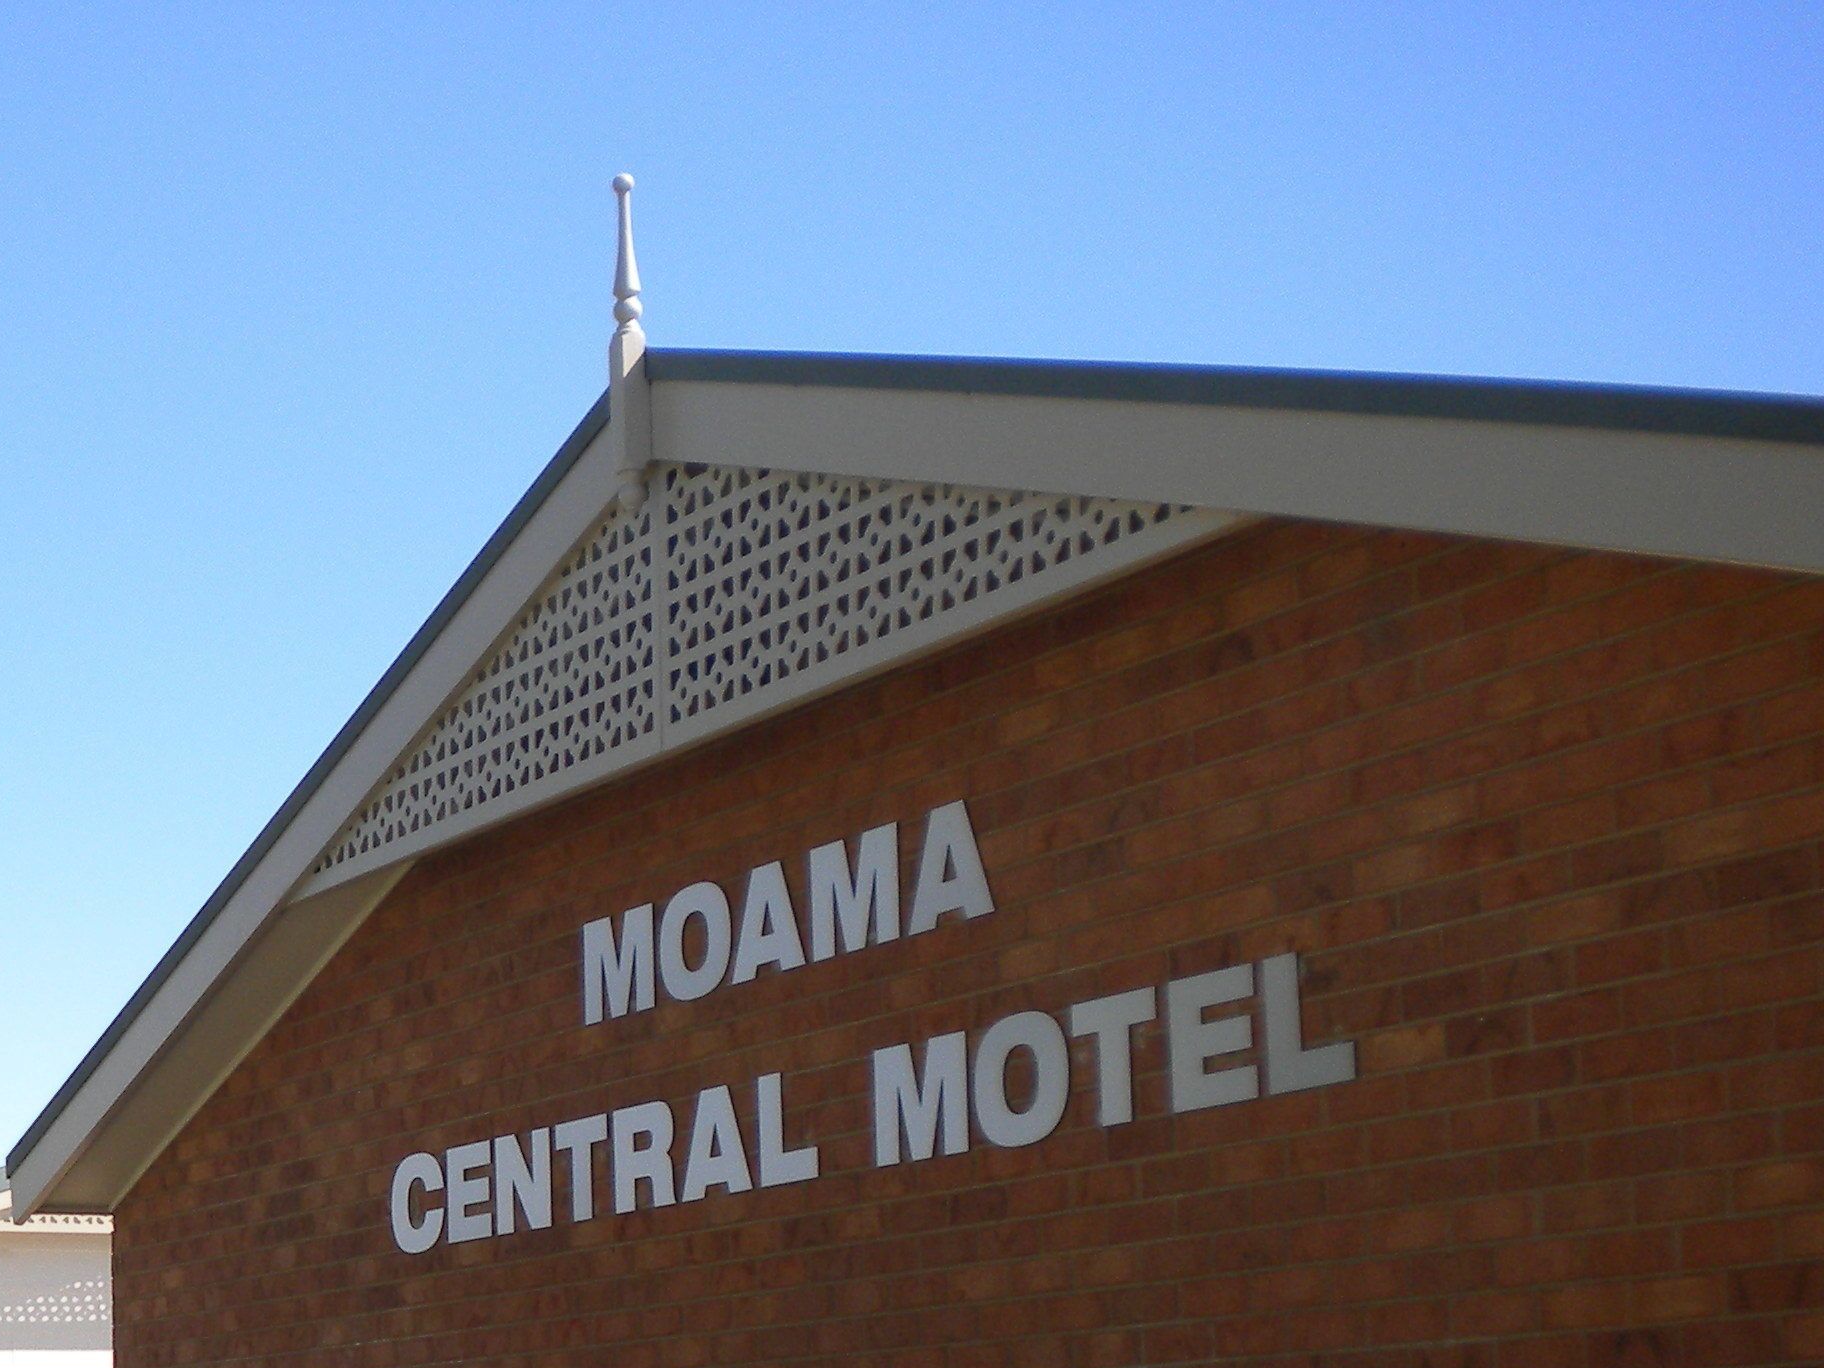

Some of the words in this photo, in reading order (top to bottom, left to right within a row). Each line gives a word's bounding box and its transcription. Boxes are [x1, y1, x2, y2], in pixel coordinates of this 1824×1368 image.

[582, 798, 995, 1028] MOAMA
[389, 1072, 820, 1255] CENTRAL
[872, 951, 1356, 1168] MOTEL
